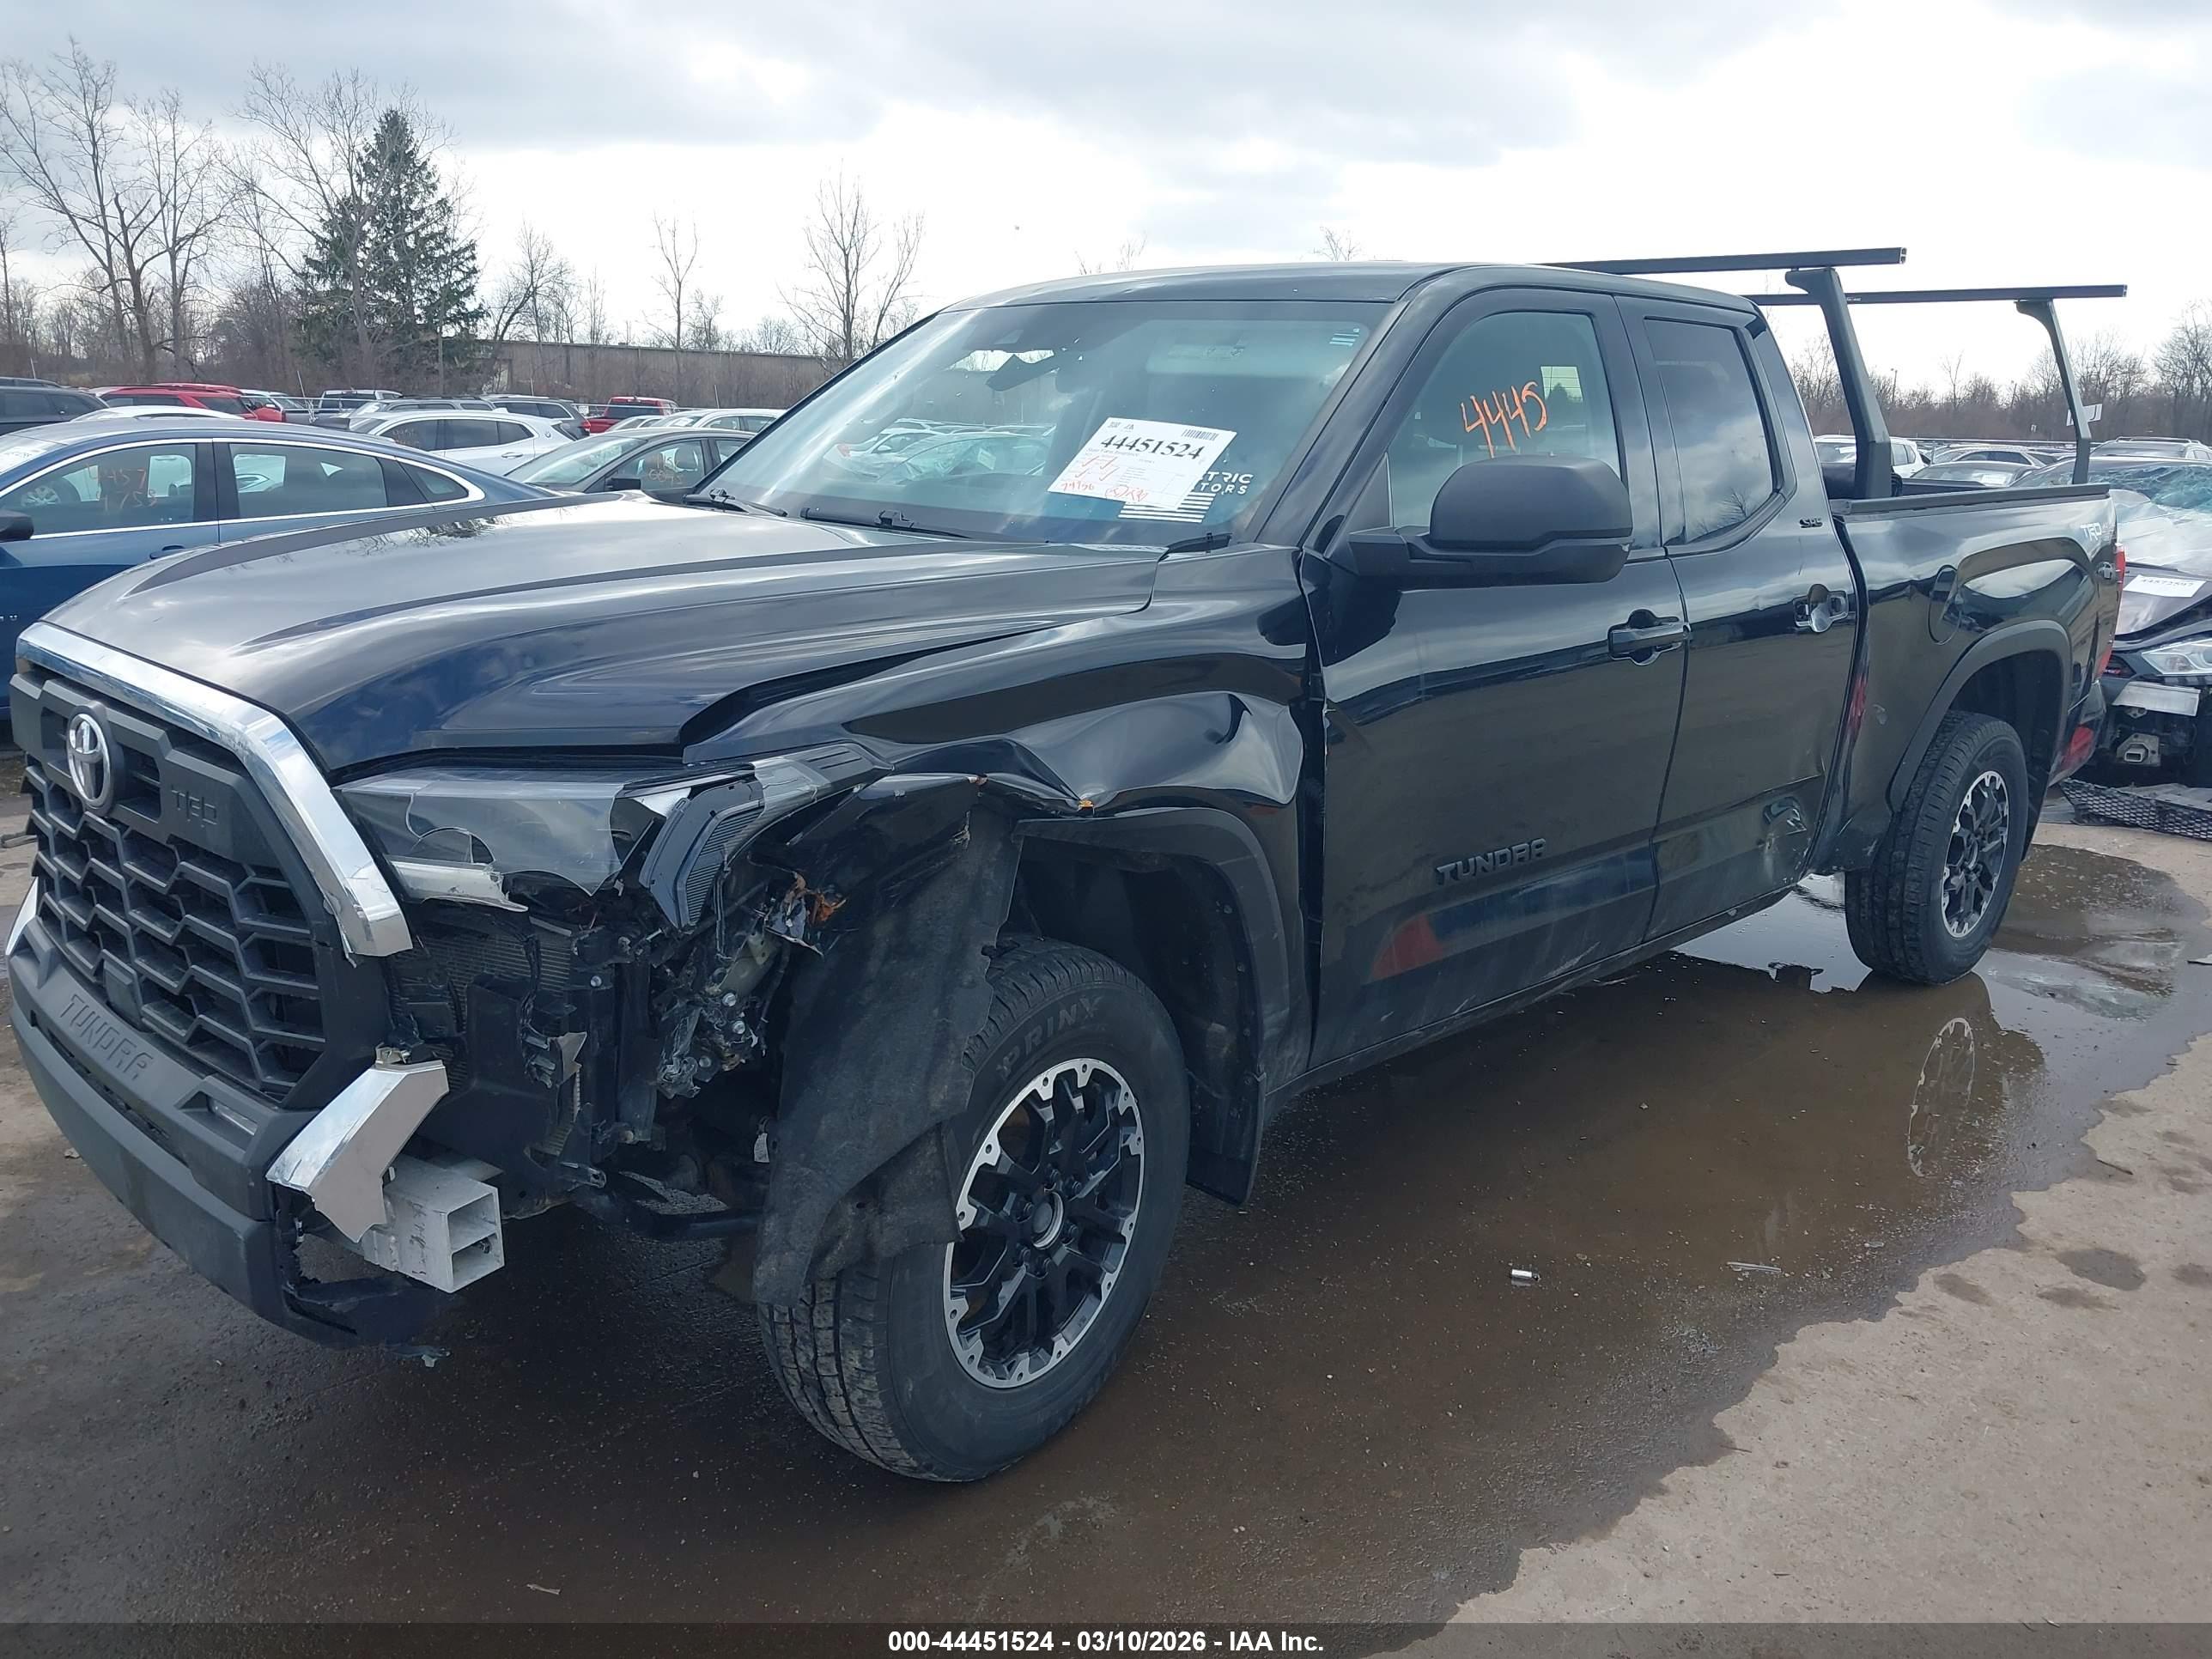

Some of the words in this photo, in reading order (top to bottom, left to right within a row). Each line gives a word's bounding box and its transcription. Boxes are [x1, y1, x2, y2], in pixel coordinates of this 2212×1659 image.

[1461, 380, 1548, 459] 4445
[1101, 434, 1205, 460] 44451524
[1200, 483, 1248, 495] TORS
[1206, 471, 1254, 484] TRIC
[2080, 521, 2102, 542] TRD
[1436, 837, 1547, 886] TUNDRA
[59, 994, 155, 1081] TUNDRA
